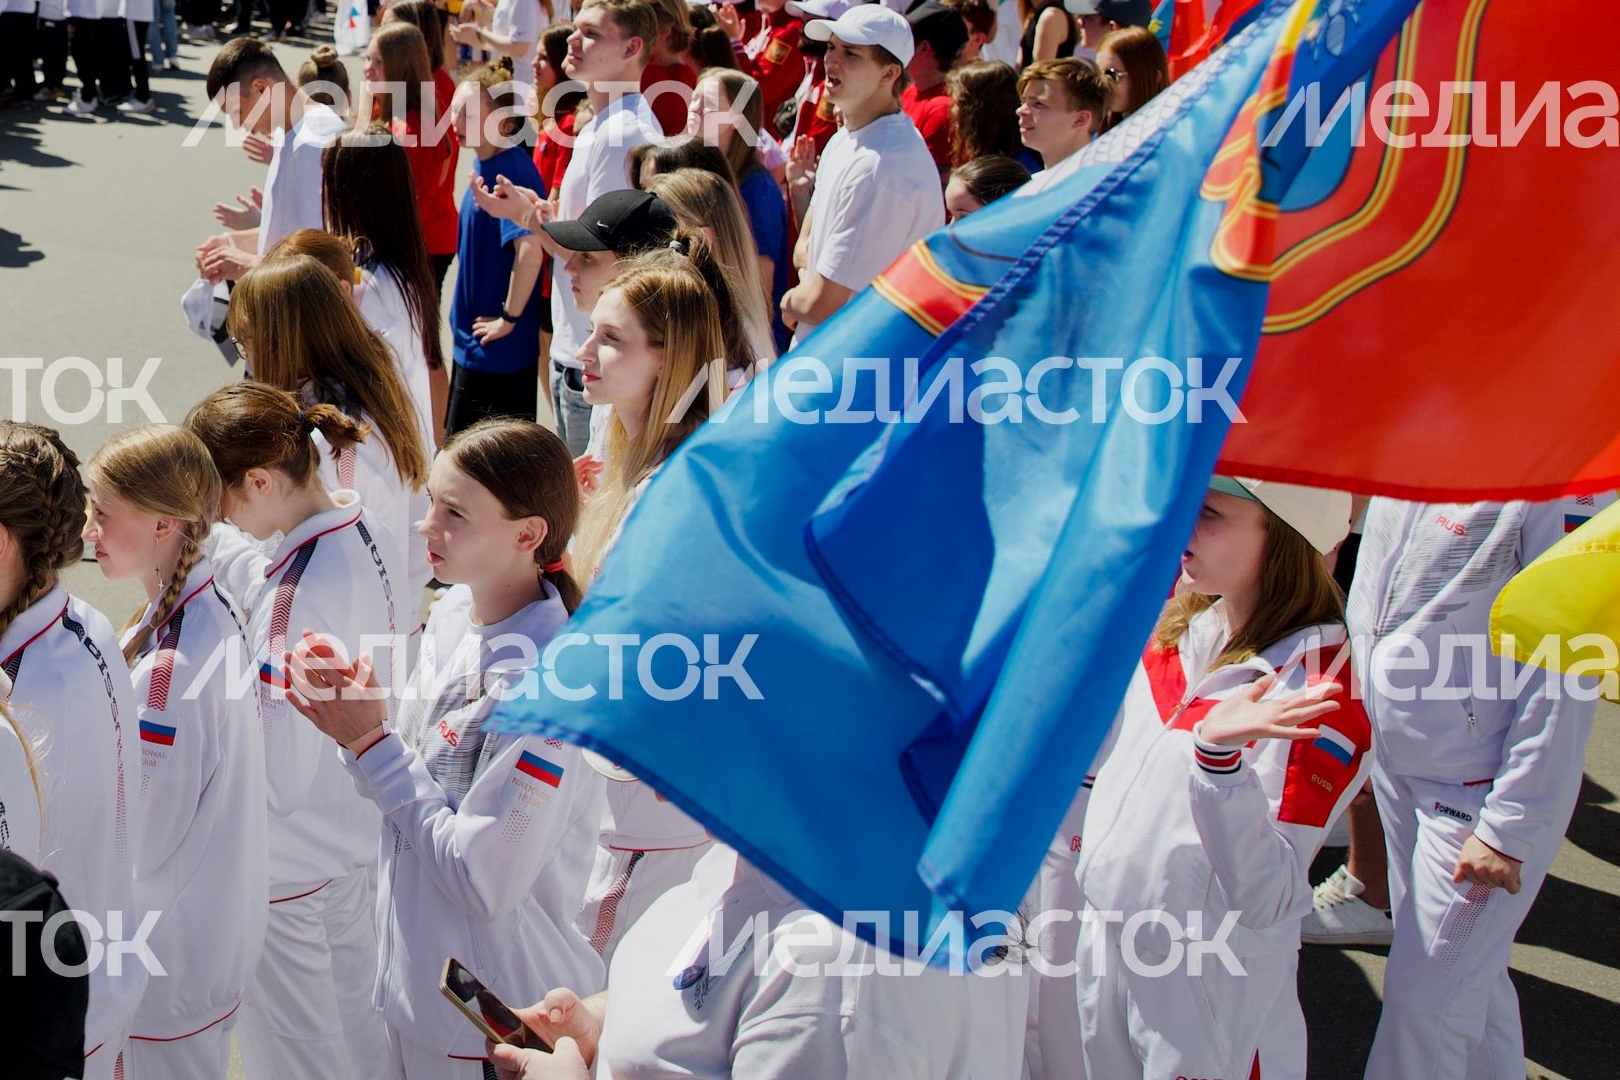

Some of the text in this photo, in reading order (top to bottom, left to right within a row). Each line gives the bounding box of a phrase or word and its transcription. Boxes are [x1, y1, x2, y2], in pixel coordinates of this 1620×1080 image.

[1436, 515, 1467, 536] RUS
[437, 720, 459, 748] RUS
[1434, 801, 1472, 822] FORWARD
